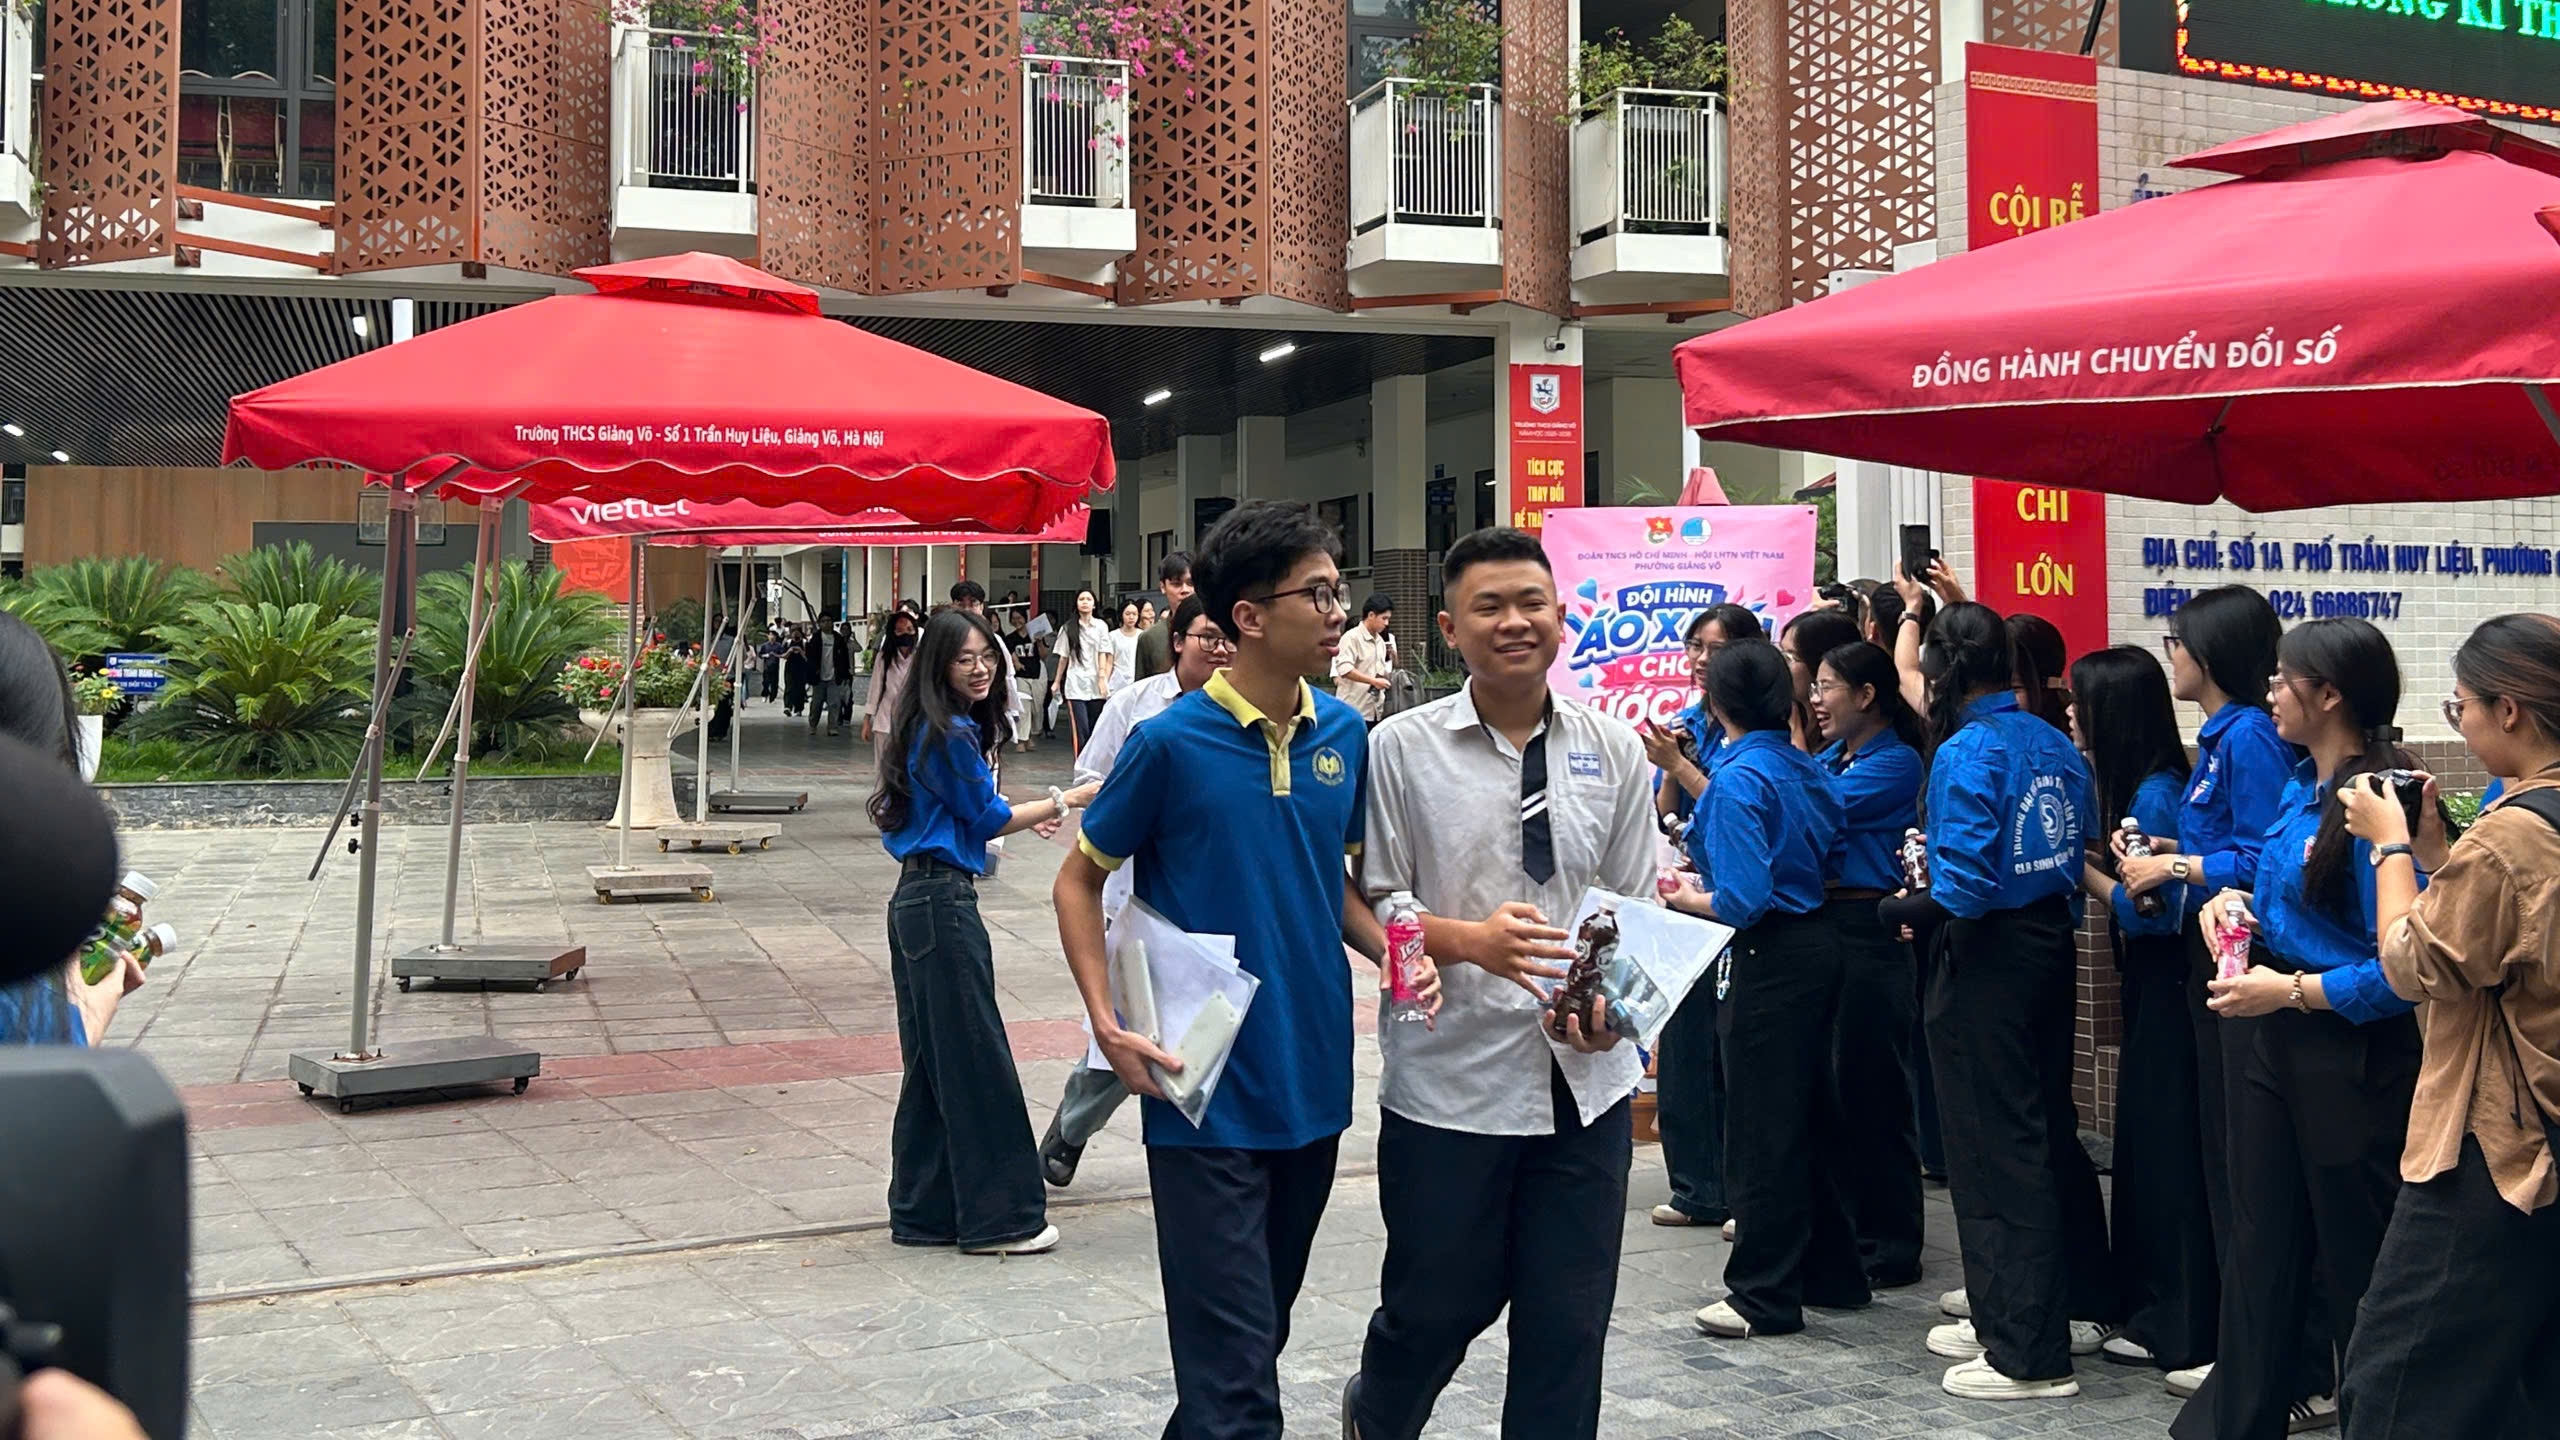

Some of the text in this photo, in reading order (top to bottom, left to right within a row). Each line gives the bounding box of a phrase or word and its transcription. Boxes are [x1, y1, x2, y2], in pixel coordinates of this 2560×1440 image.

[1989, 184, 2041, 236] CỘI
[1912, 324, 2343, 388] ĐỒNG HÀNH CHUYỂN ĐỔI SỐ
[514, 424, 560, 445] Trường
[561, 425, 596, 442] THCS
[598, 424, 634, 445] Giảng
[636, 426, 653, 442] Võ
[663, 424, 681, 443] Số
[683, 427, 691, 443] 1
[693, 424, 722, 444] Trần
[725, 427, 750, 448] Huy
[752, 427, 781, 447] Liệu,
[784, 427, 820, 449] Giảng
[843, 429, 861, 446] Hà
[863, 430, 884, 448] Nội
[568, 497, 691, 526] viettel
[2016, 487, 2069, 522] CHI
[1605, 551, 1627, 560] TNCS
[1644, 550, 1660, 560] CHÍ
[1662, 551, 1688, 559] MINH
[1762, 551, 1785, 560] NAM
[2143, 537, 2178, 576] ĐỊA
[2183, 530, 2225, 569] CHỈ:
[2229, 531, 2257, 571] SỐ
[2260, 541, 2284, 572] 1A
[2293, 534, 2335, 572] PHỐ
[2393, 545, 2430, 574] HUY
[2435, 539, 2479, 579] LIỆU,
[2016, 552, 2075, 597] LỚN
[1626, 583, 1713, 609] ĐỘI HÌNH
[2268, 589, 2307, 620] 024
[1571, 607, 1646, 659] ÁO
[2014, 861, 2033, 876] CLB
